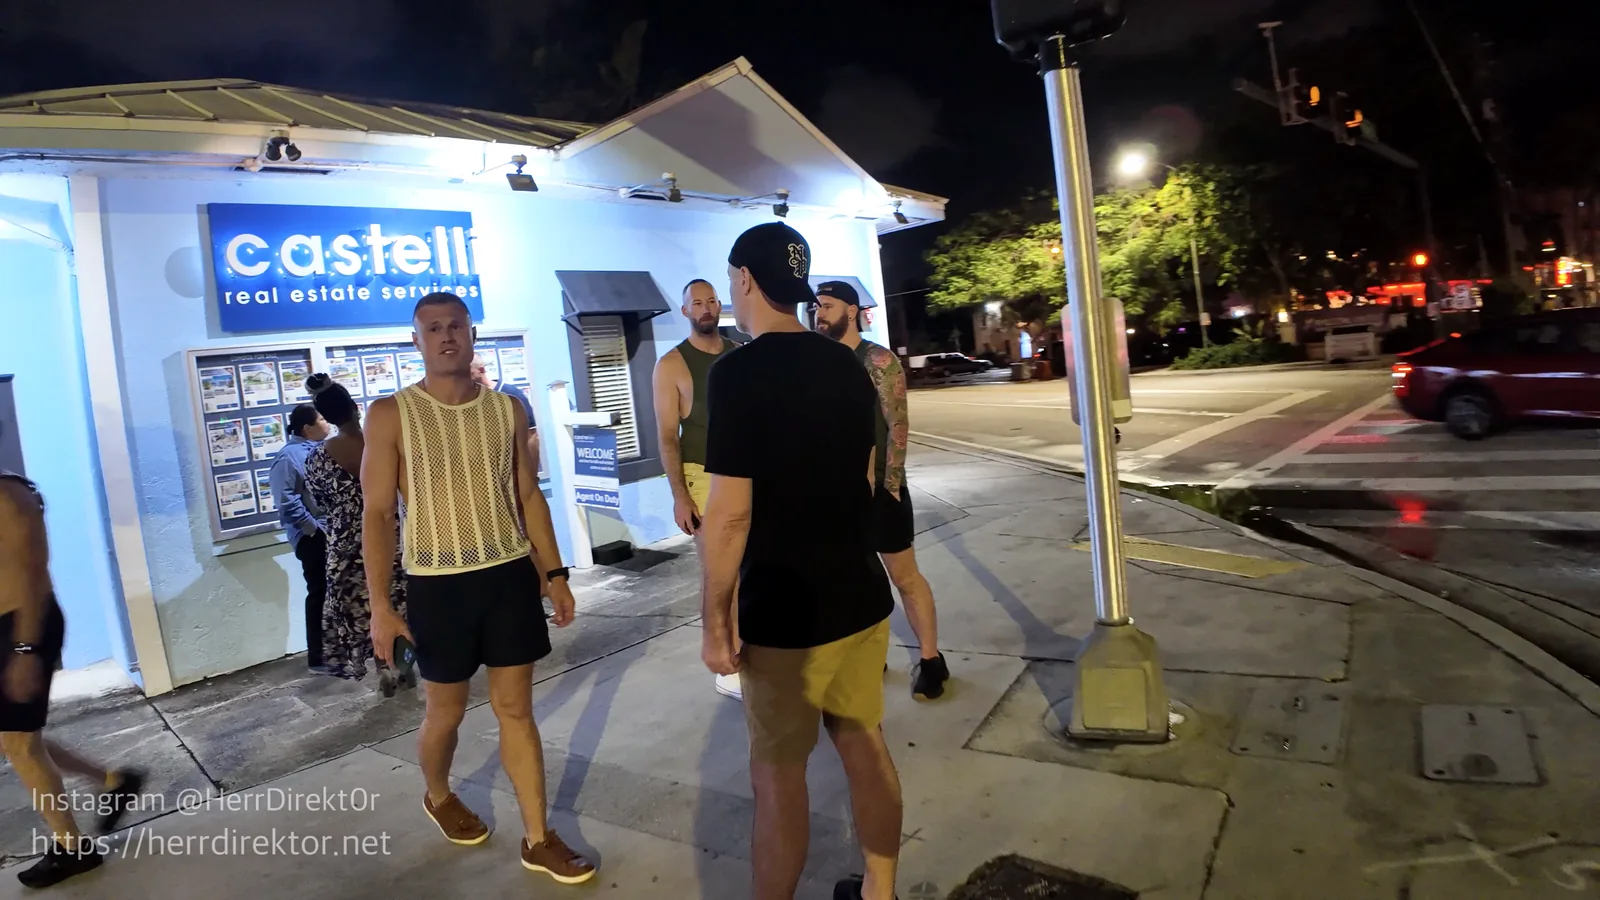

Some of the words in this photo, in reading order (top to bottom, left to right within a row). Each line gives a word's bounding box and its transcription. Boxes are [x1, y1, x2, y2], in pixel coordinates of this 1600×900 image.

[225, 287, 279, 305] real
[290, 284, 371, 303] estate
[576, 448, 614, 460] WELCOME
[576, 492, 594, 502] Agent
[595, 494, 604, 502] On
[605, 495, 619, 506] Duty
